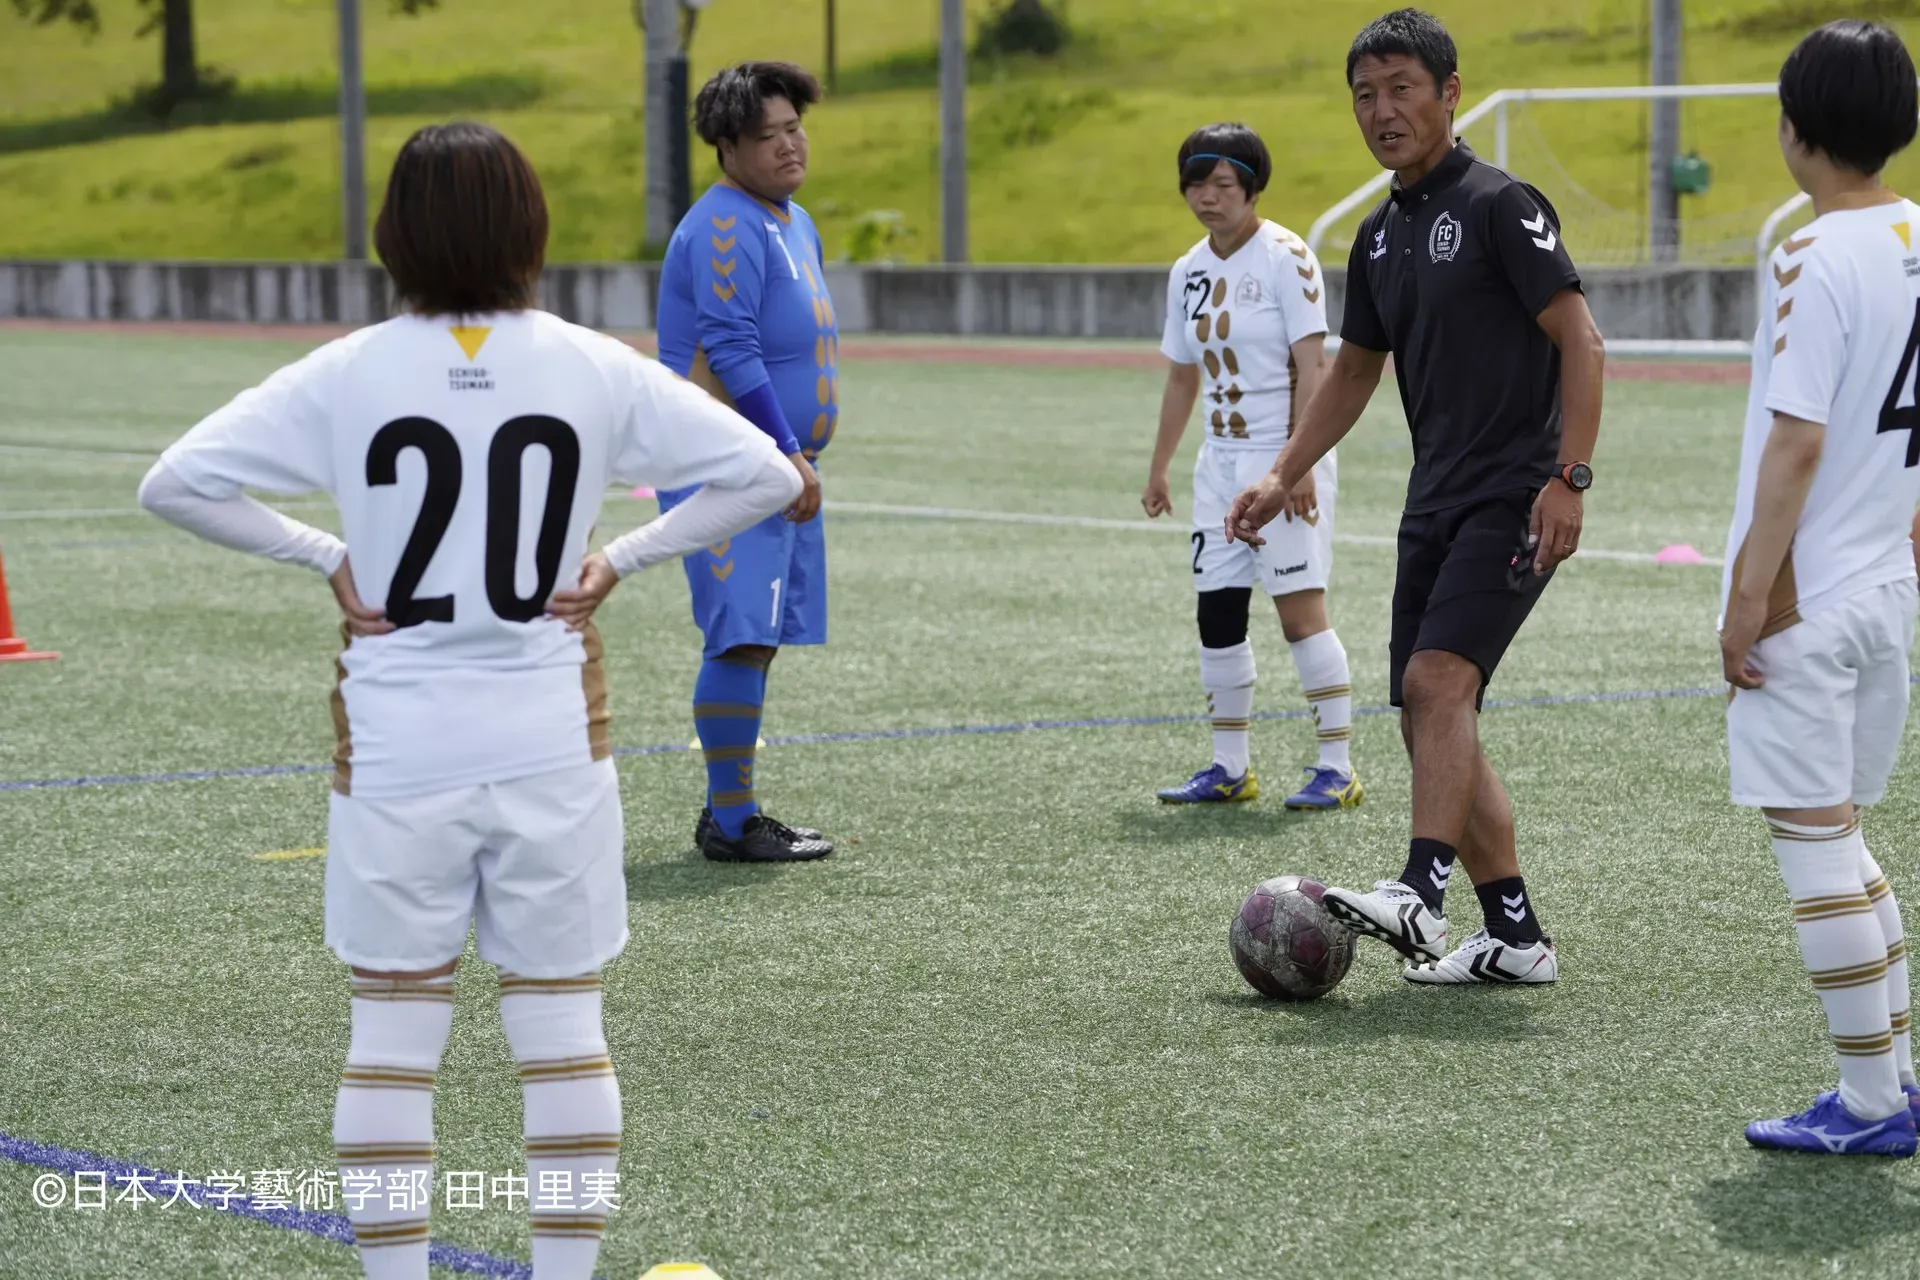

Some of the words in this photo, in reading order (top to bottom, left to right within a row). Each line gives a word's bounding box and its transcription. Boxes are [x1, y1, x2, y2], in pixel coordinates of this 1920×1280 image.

[776, 233, 799, 280] 1
[1437, 224, 1453, 242] FC
[1876, 296, 1920, 468] 4
[365, 414, 581, 633] 20
[1274, 560, 1308, 577] hummel
[770, 577, 781, 627] 1
